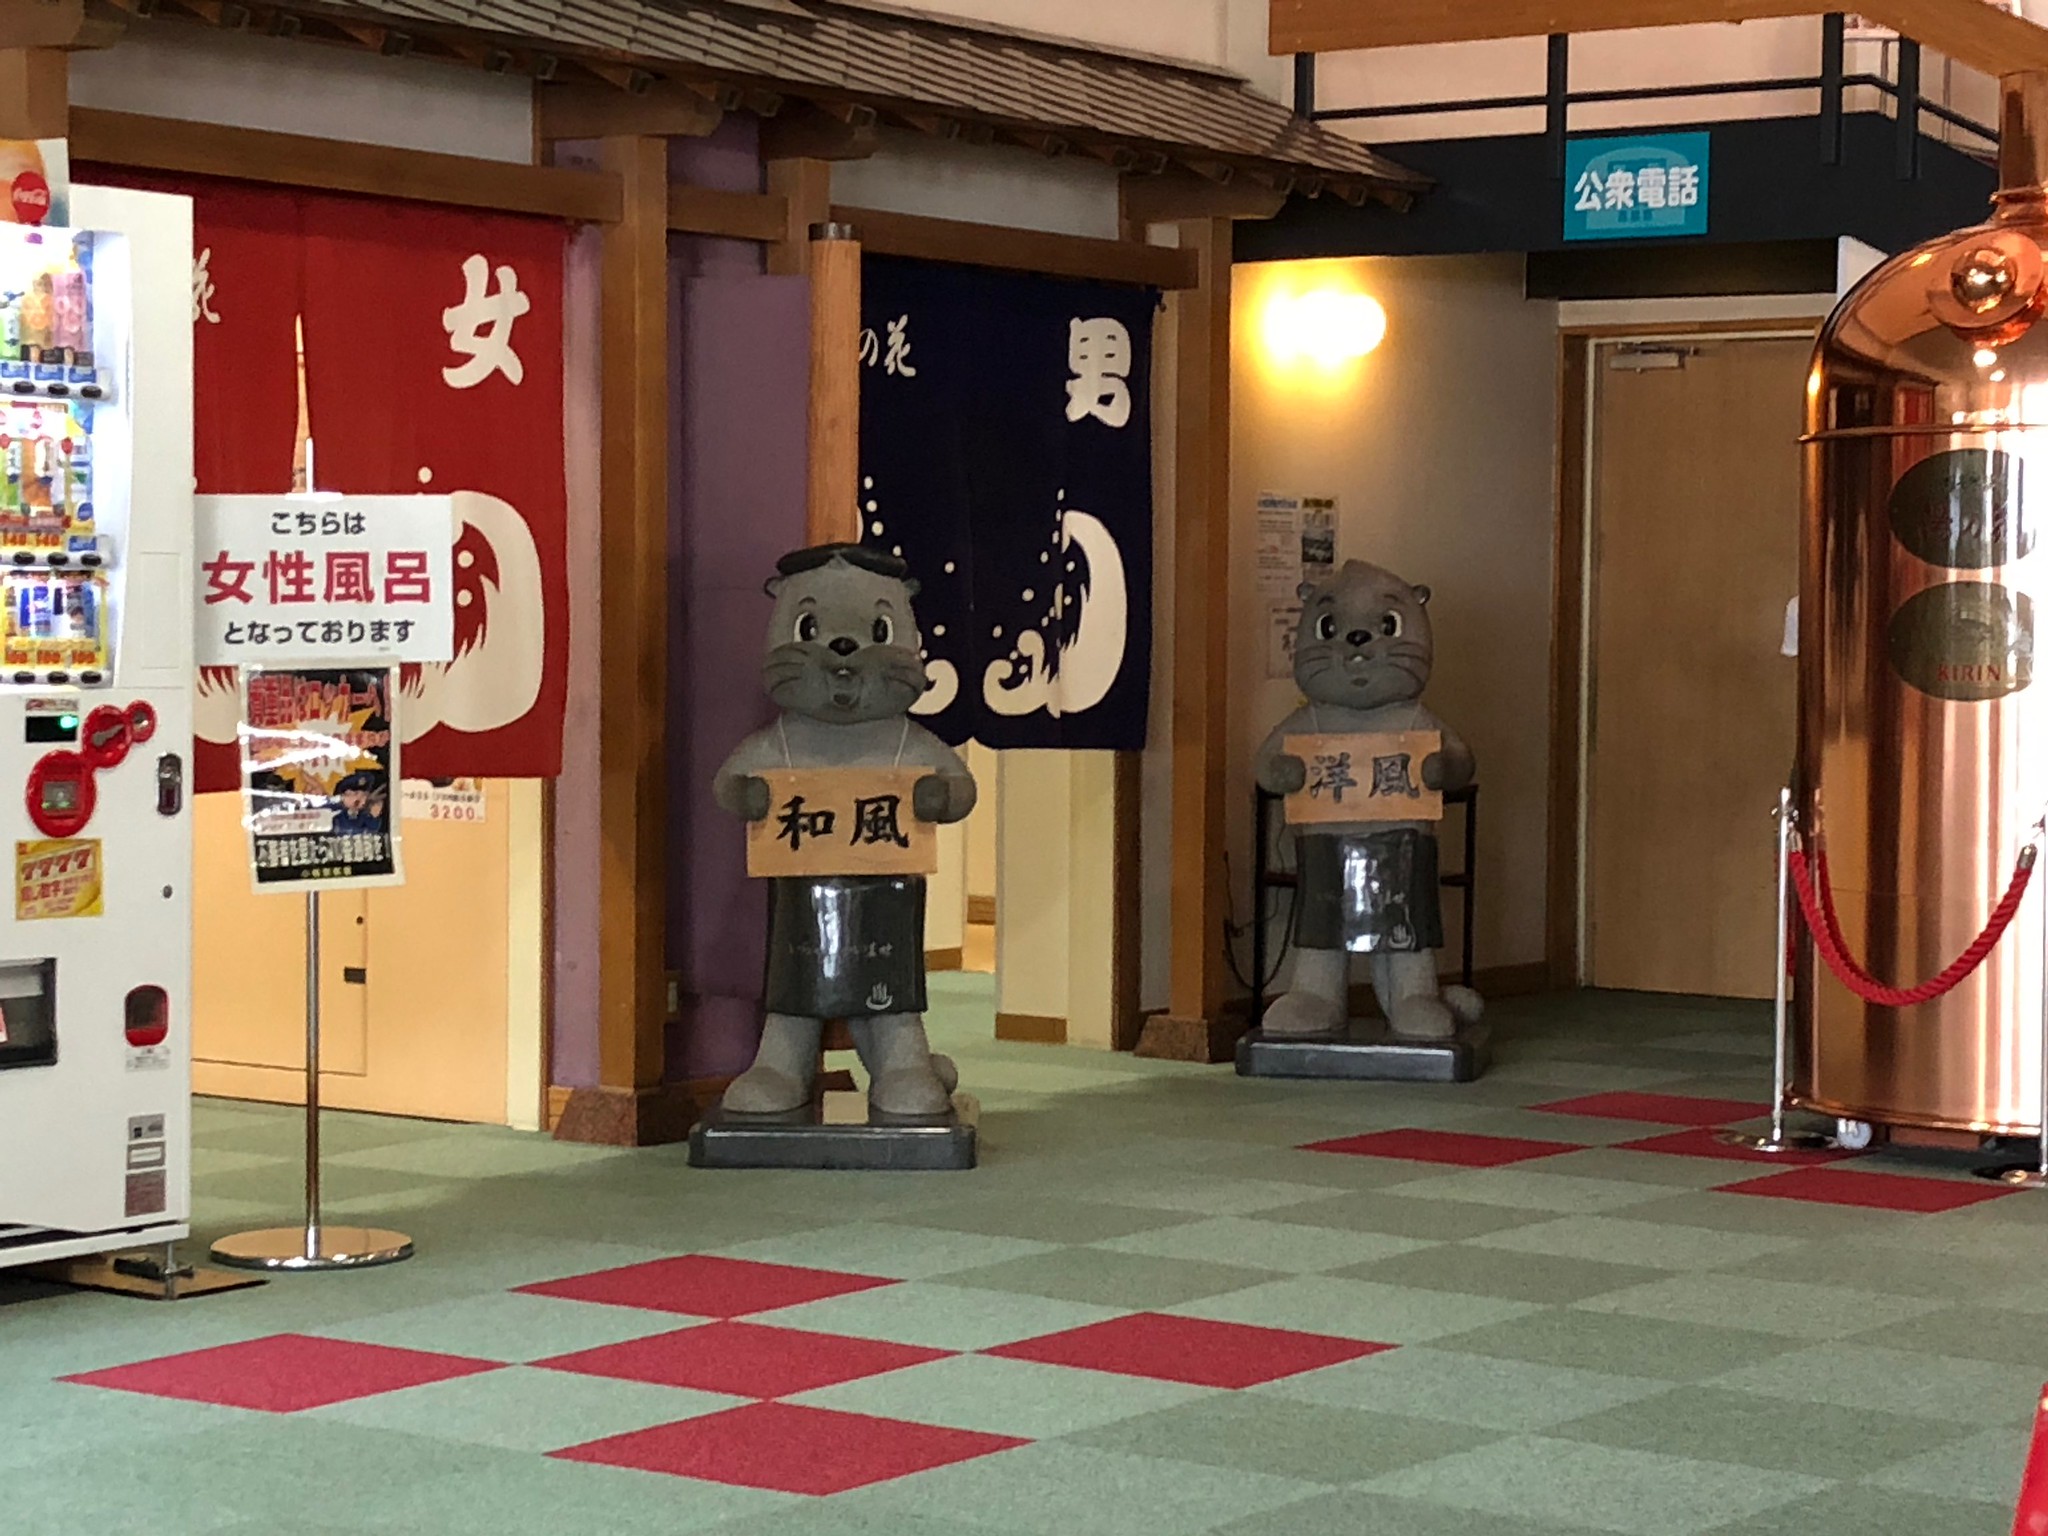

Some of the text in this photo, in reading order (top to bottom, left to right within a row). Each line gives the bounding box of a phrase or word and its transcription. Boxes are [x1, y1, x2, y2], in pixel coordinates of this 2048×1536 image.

[1574, 165, 1699, 211] 公衆電話
[442, 254, 531, 389] 女
[1065, 317, 1132, 428] 男
[271, 511, 366, 535] こちらは
[202, 550, 431, 604] 女性風呂
[224, 619, 415, 644] となっております
[1936, 663, 2001, 682] KIRIN
[1310, 752, 1421, 804] 洋風
[430, 803, 475, 820] 3200
[776, 795, 909, 851] 和風
[21, 848, 92, 882] 7777
